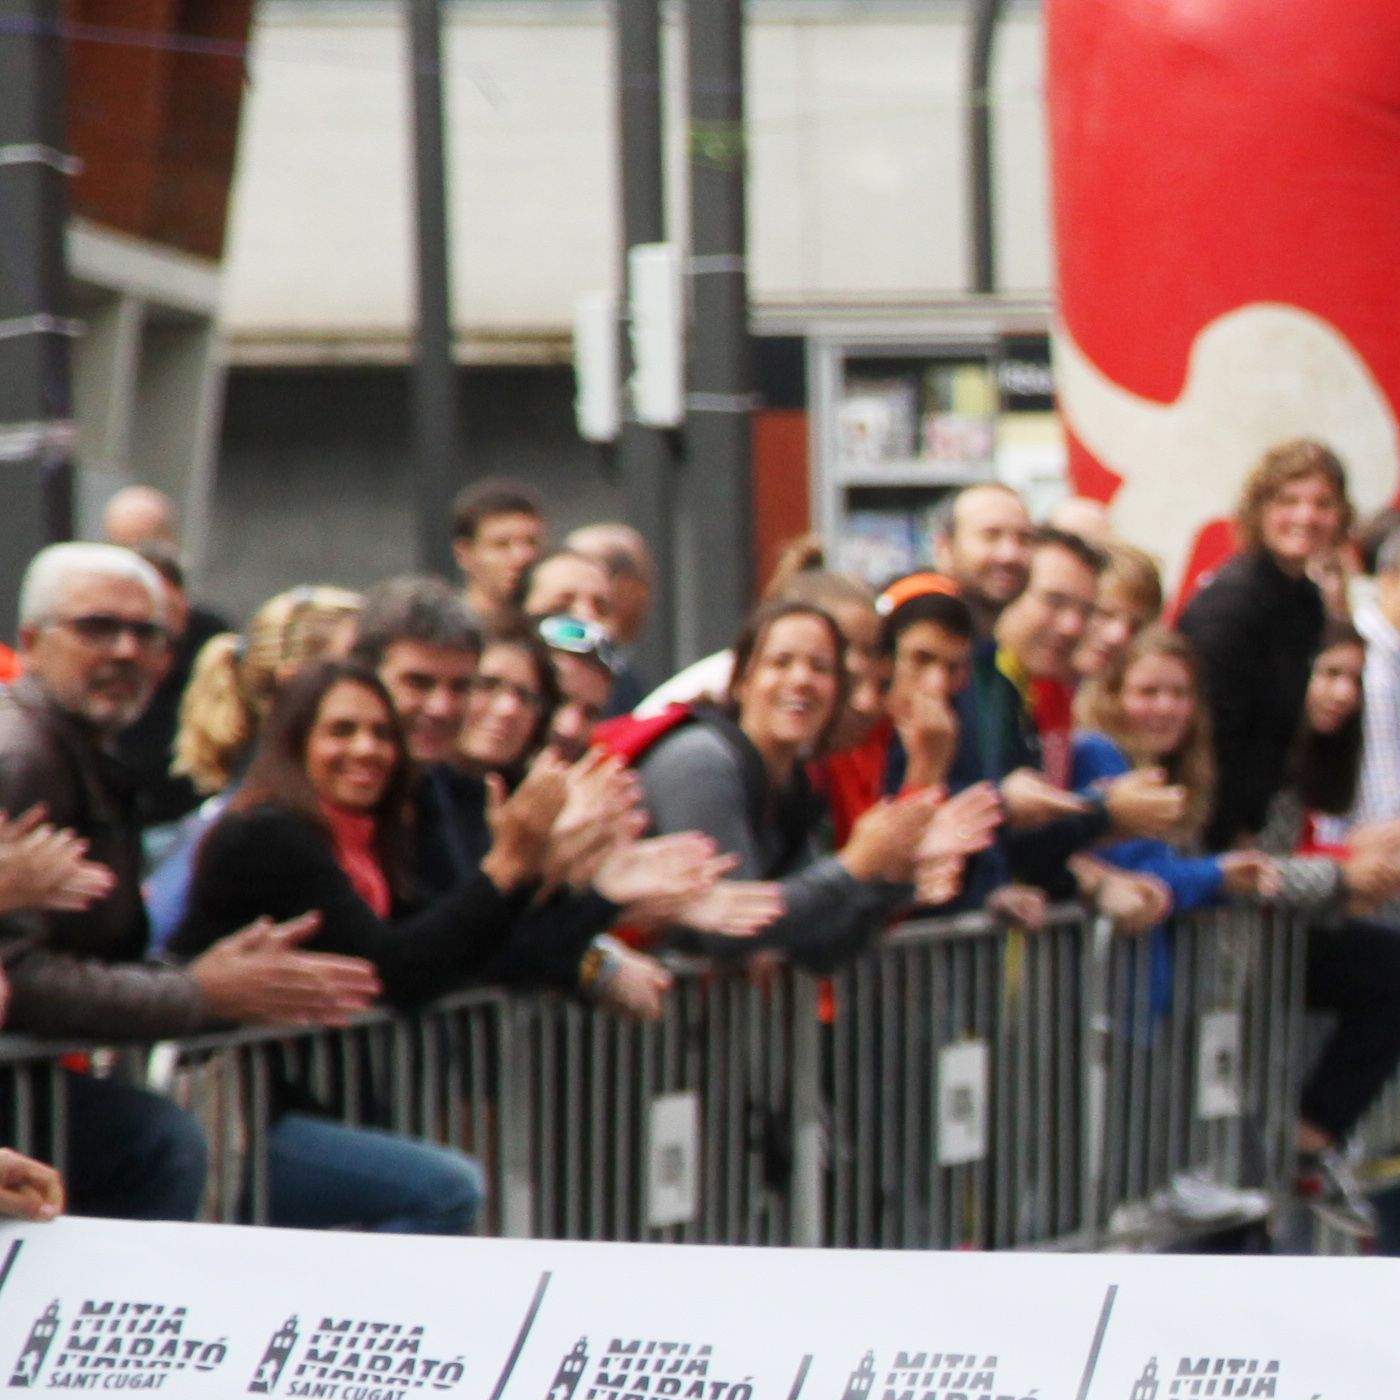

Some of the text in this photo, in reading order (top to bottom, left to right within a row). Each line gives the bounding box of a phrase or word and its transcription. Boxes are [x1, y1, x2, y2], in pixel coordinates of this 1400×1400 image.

[70, 1300, 188, 1335] MITJA
[309, 1317, 425, 1354] MITJA
[56, 1335, 229, 1371] MARATÓ
[295, 1347, 465, 1389] MARATÓ
[599, 1338, 713, 1376] MITJA
[886, 1351, 999, 1390] MITJA
[46, 1372, 167, 1389] SANT CUGAT
[286, 1381, 341, 1399] SANT
[1169, 1357, 1280, 1398] MITJA
